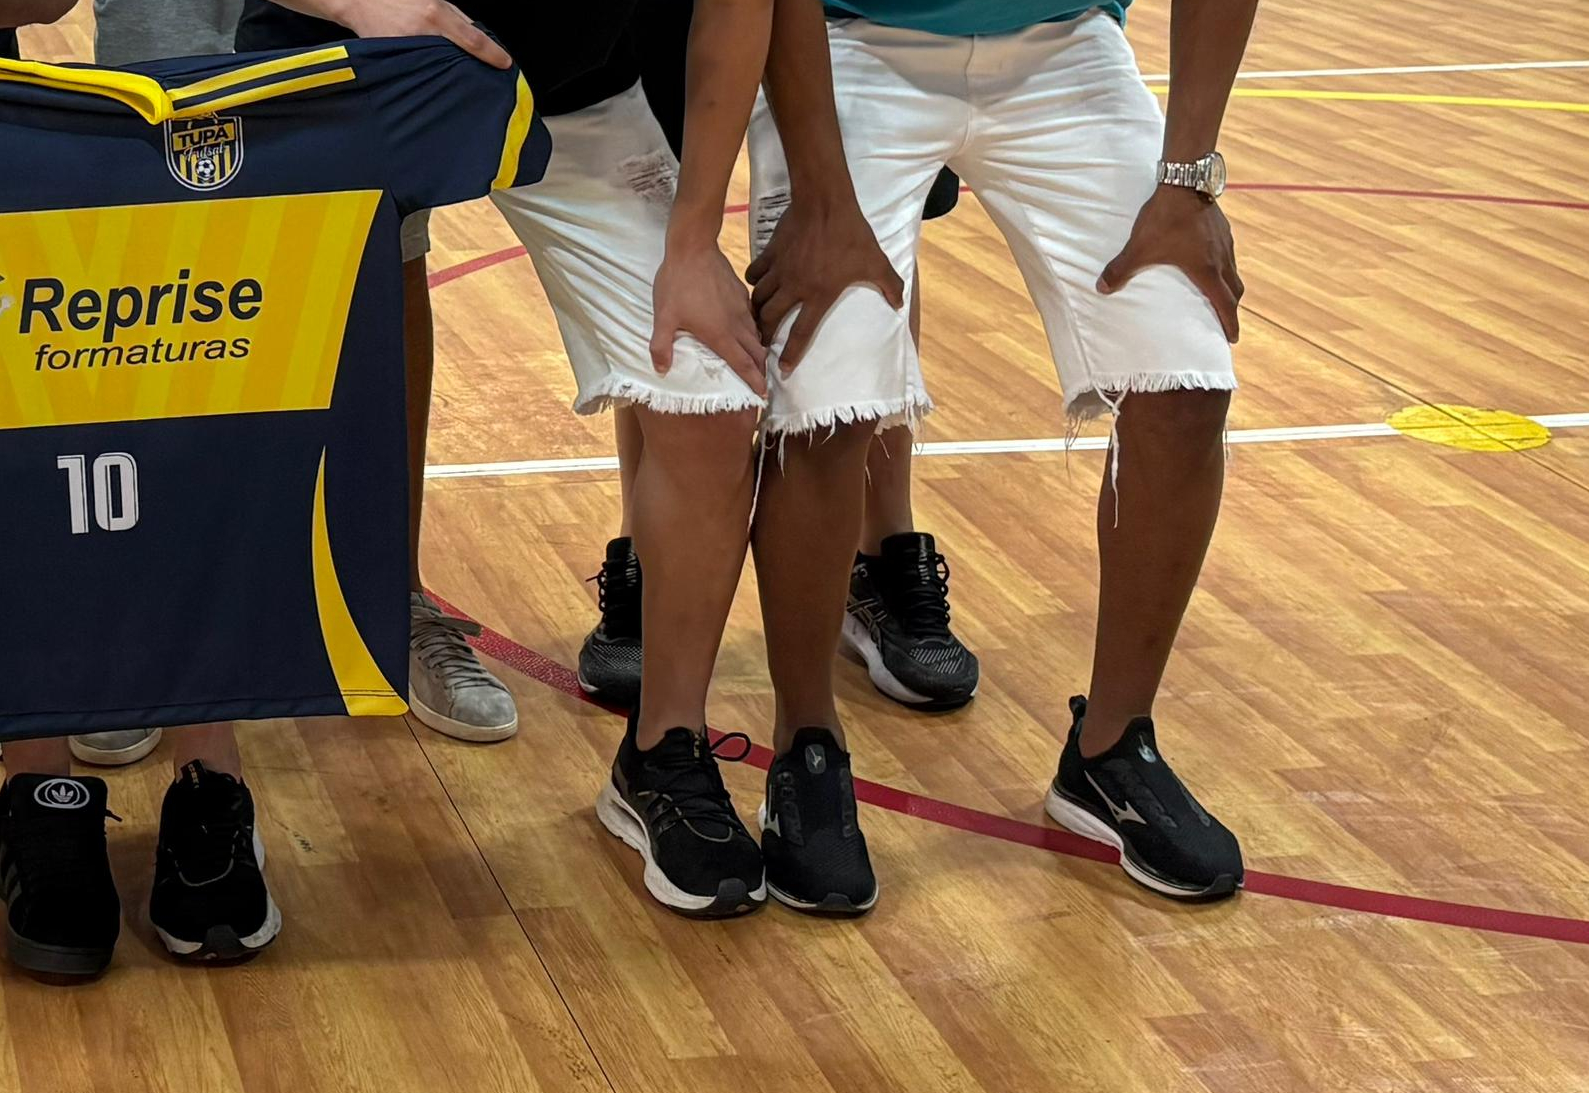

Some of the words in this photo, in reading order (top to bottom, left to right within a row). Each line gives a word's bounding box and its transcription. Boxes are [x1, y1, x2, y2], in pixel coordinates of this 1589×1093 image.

[18, 268, 264, 343] Reprise
[34, 337, 251, 372] formaturas
[57, 452, 139, 535] 10
